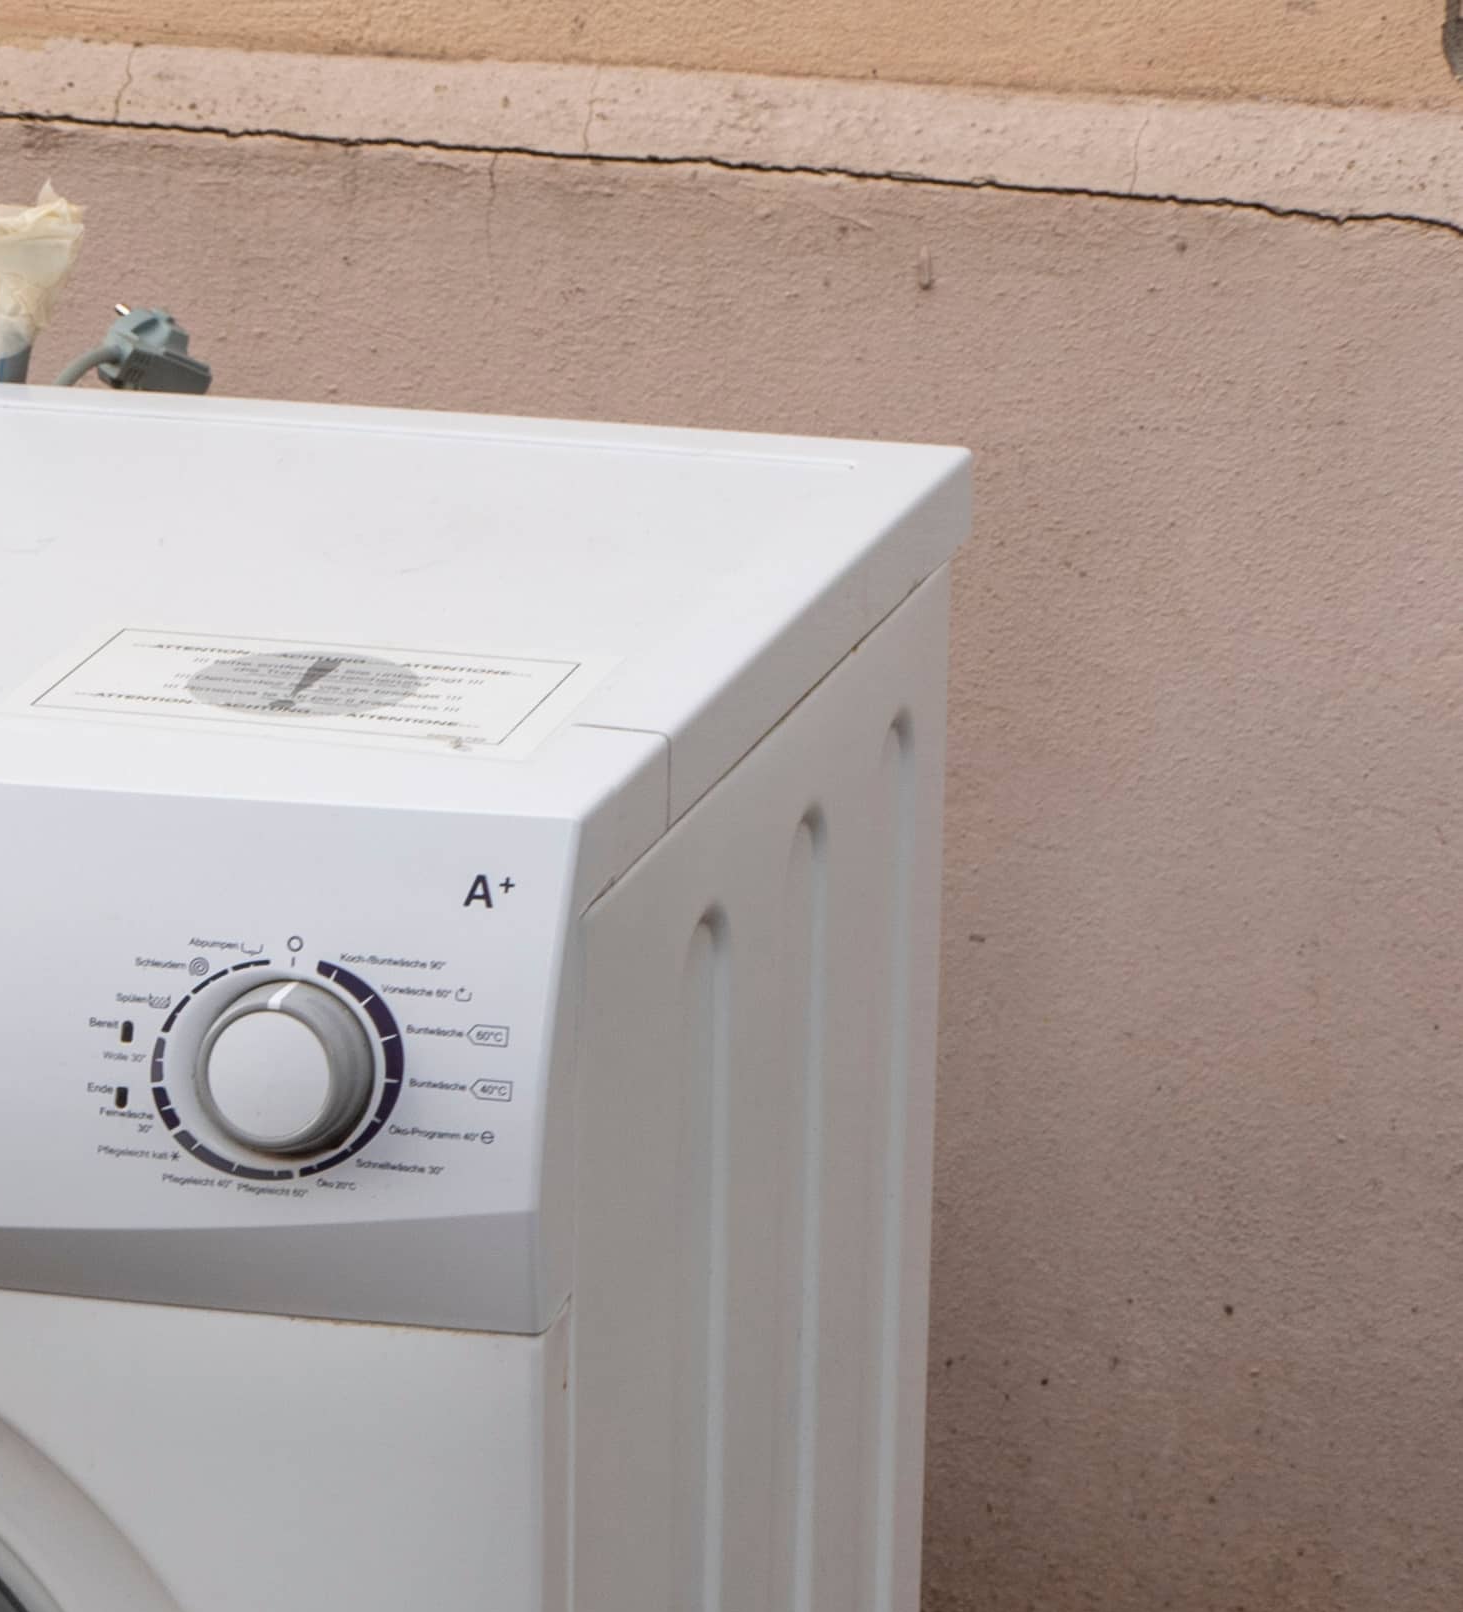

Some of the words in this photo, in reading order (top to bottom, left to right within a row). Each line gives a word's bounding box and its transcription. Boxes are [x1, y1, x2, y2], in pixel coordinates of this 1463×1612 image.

[463, 873, 516, 909] A+
[188, 937, 239, 951] Abpumpen
[135, 957, 186, 969] Schleudern
[89, 1017, 119, 1029] Bereit
[406, 1024, 464, 1038] Buntwäsche
[87, 1082, 114, 1094] Ende
[409, 1078, 467, 1092] Buntwäsche
[356, 1158, 426, 1174] Schnellwäsche
[162, 1173, 215, 1188] Pflegeleicht
[237, 1182, 291, 1197] Pflegeleicht
